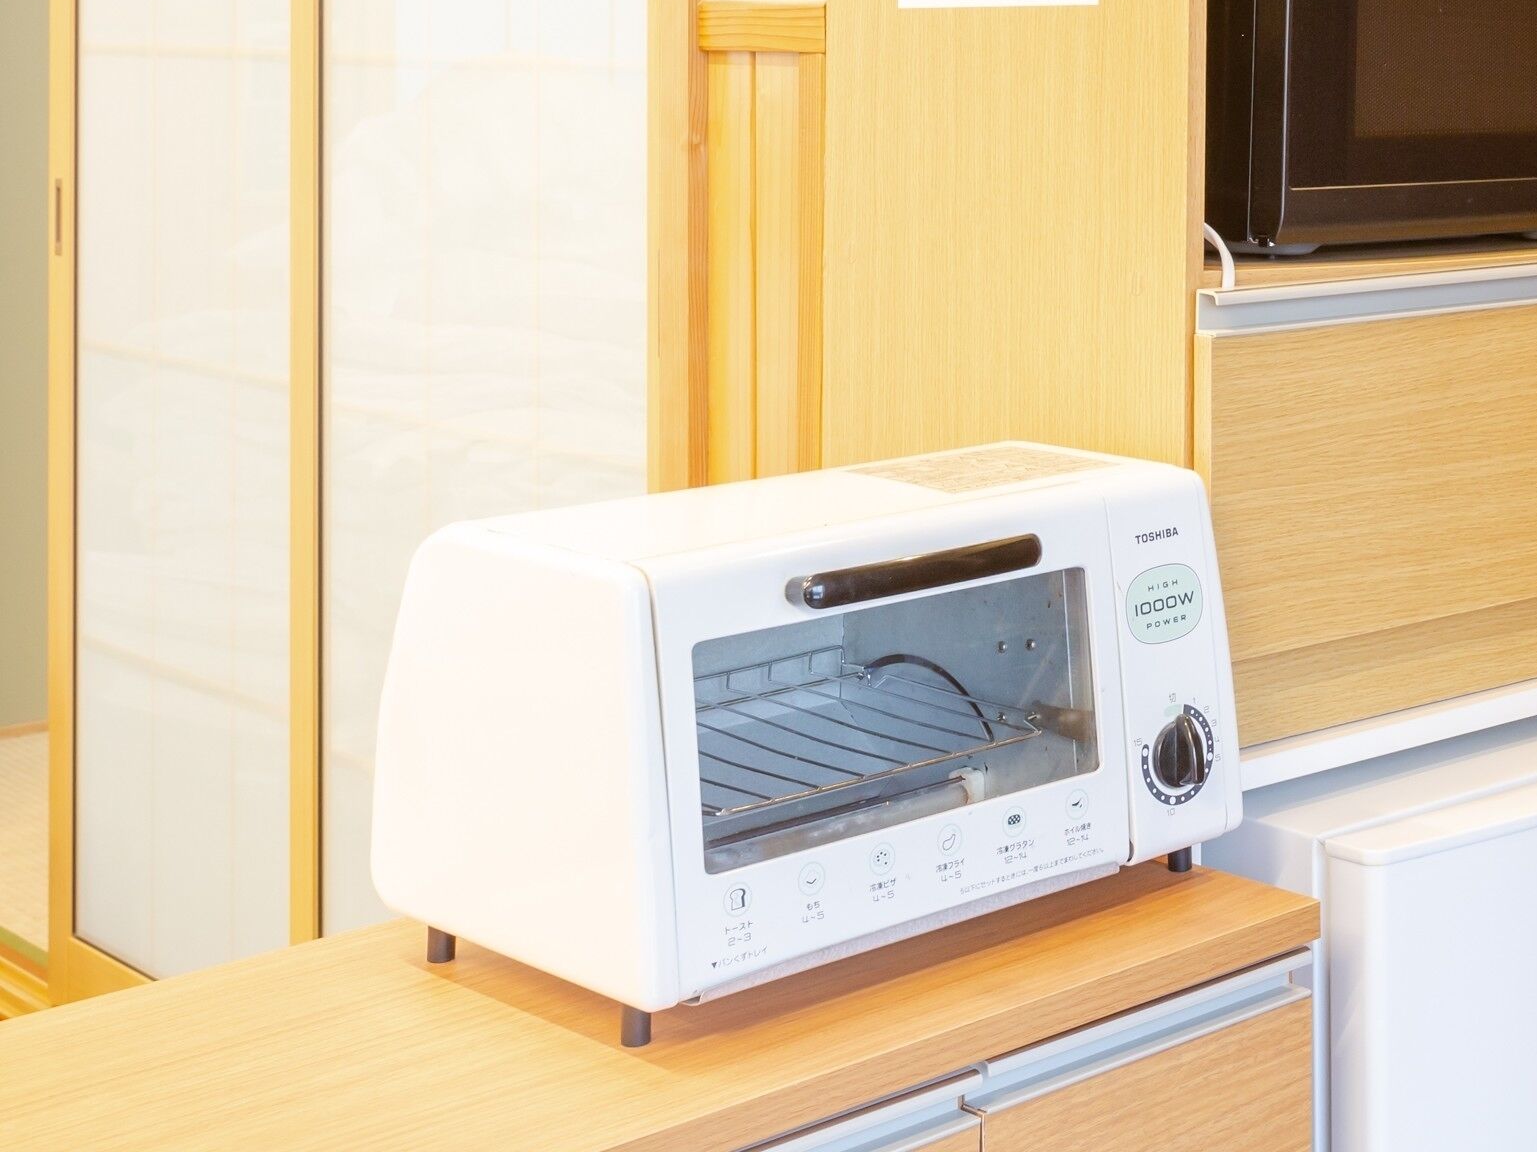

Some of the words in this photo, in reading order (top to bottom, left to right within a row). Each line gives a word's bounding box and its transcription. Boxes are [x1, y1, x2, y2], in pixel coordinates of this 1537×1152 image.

[1135, 526, 1179, 545] TOSHIBA
[1147, 578, 1179, 592] HIGH
[1134, 590, 1194, 617] 1000W
[1146, 614, 1187, 630] POWER
[724, 920, 753, 935] トースト
